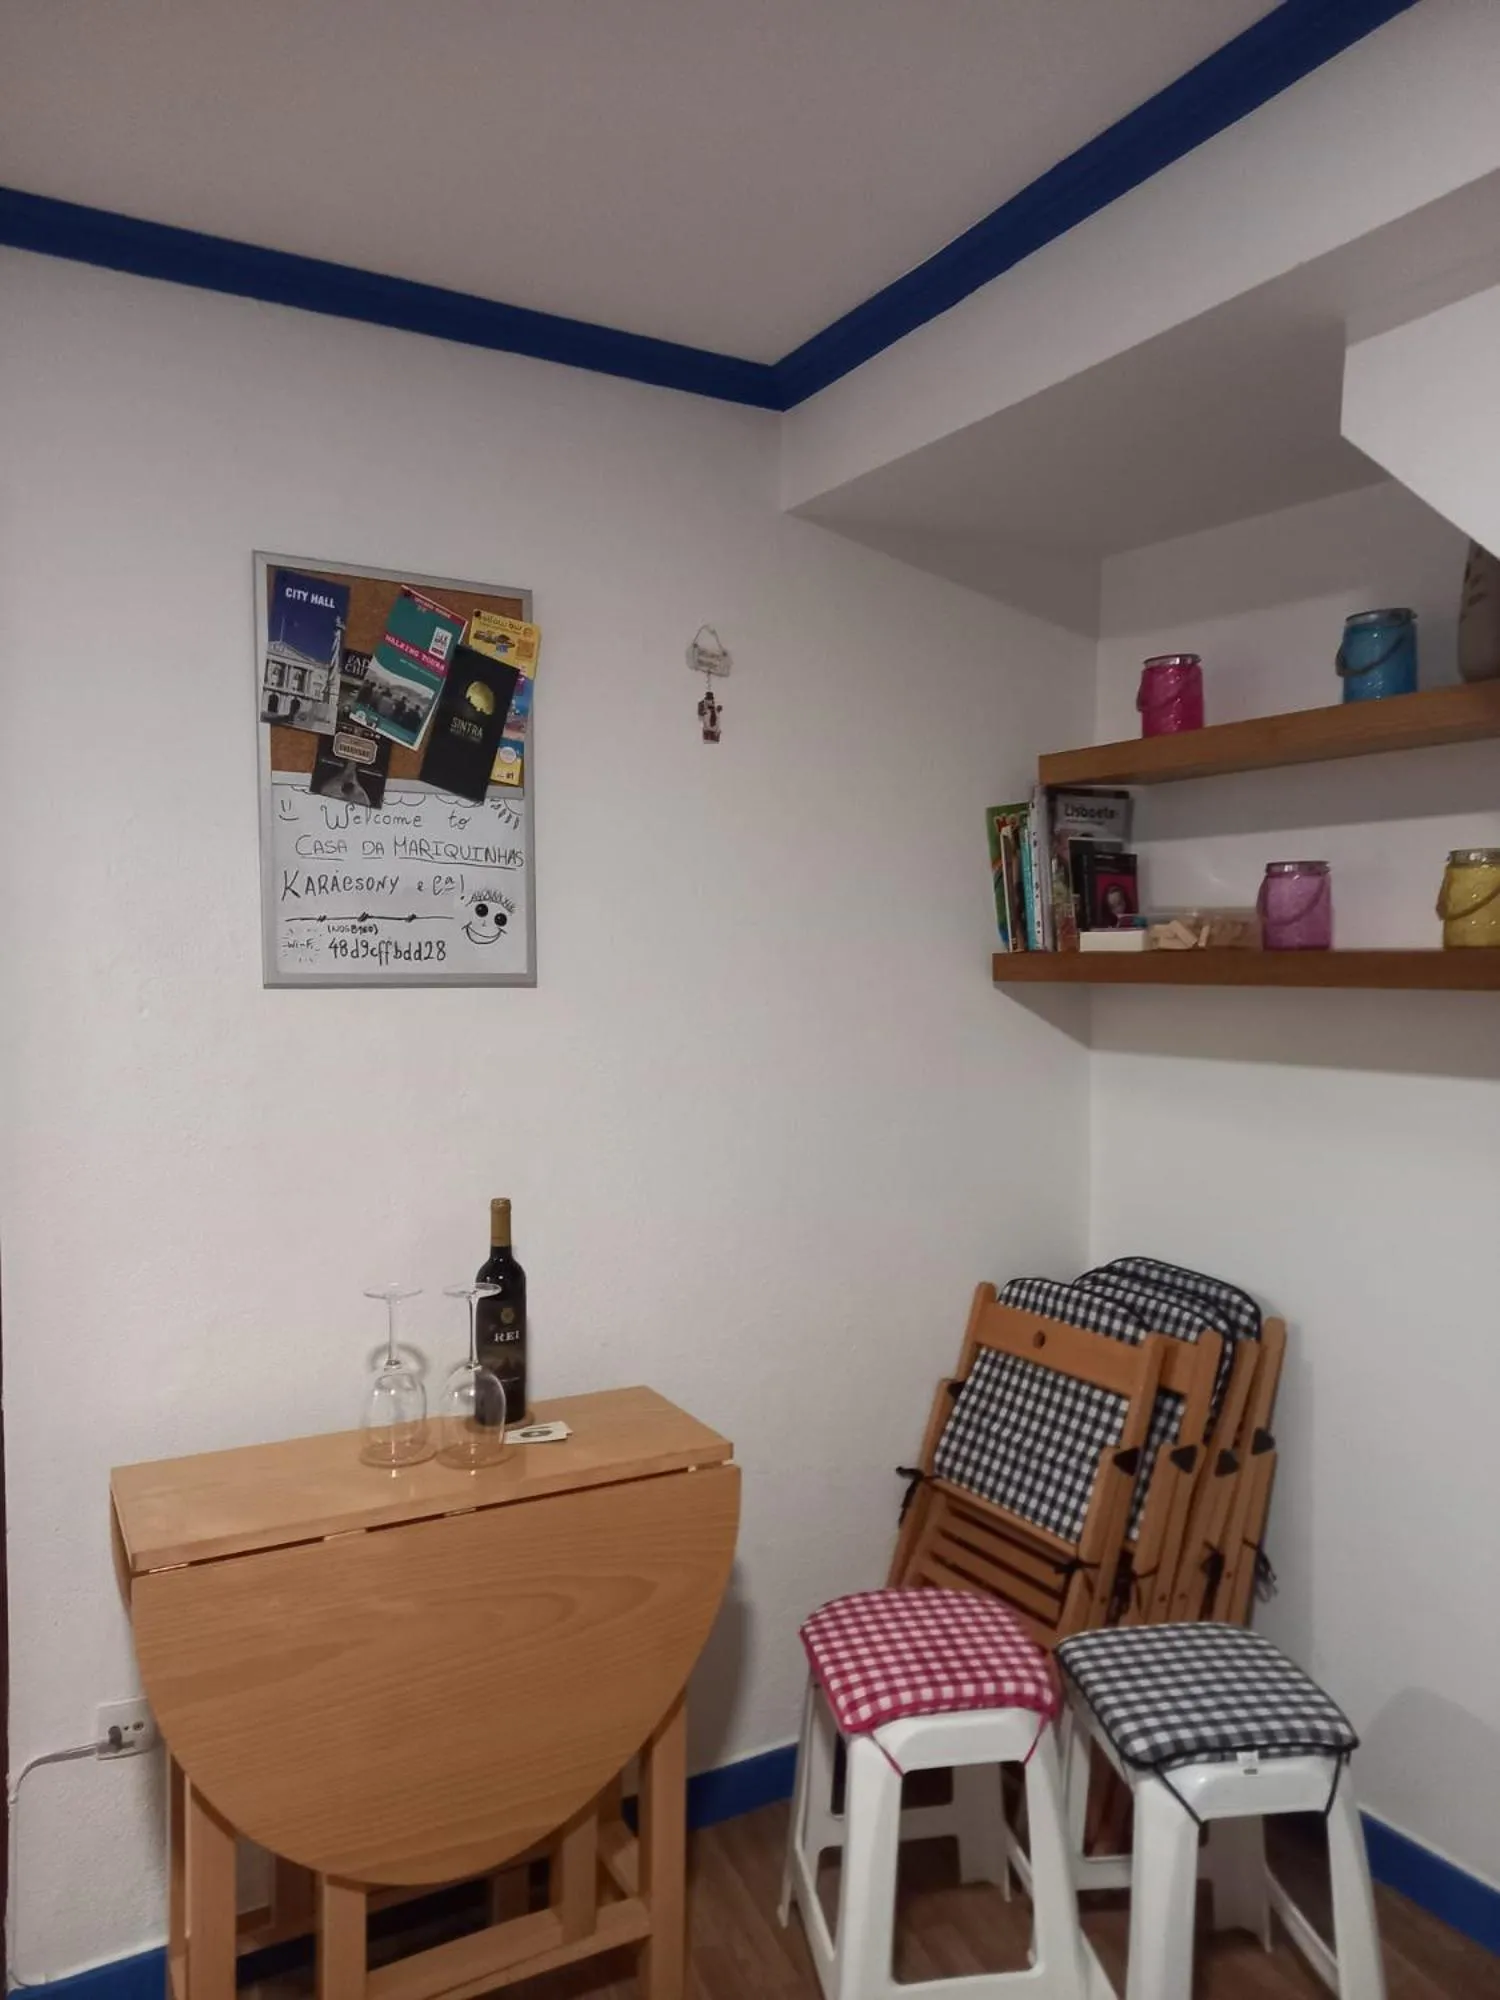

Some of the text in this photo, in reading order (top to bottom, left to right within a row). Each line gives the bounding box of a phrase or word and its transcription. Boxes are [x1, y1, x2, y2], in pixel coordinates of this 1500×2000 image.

[285, 587, 335, 608] CITY HALL
[384, 633, 420, 658] WALKING
[450, 716, 483, 738] SINTRA
[320, 801, 473, 830] Welcome to
[295, 834, 524, 868] CASA DA MARIQUINHAS
[328, 936, 447, 967] 48d9cffbdd28
[494, 1329, 520, 1342] REI
